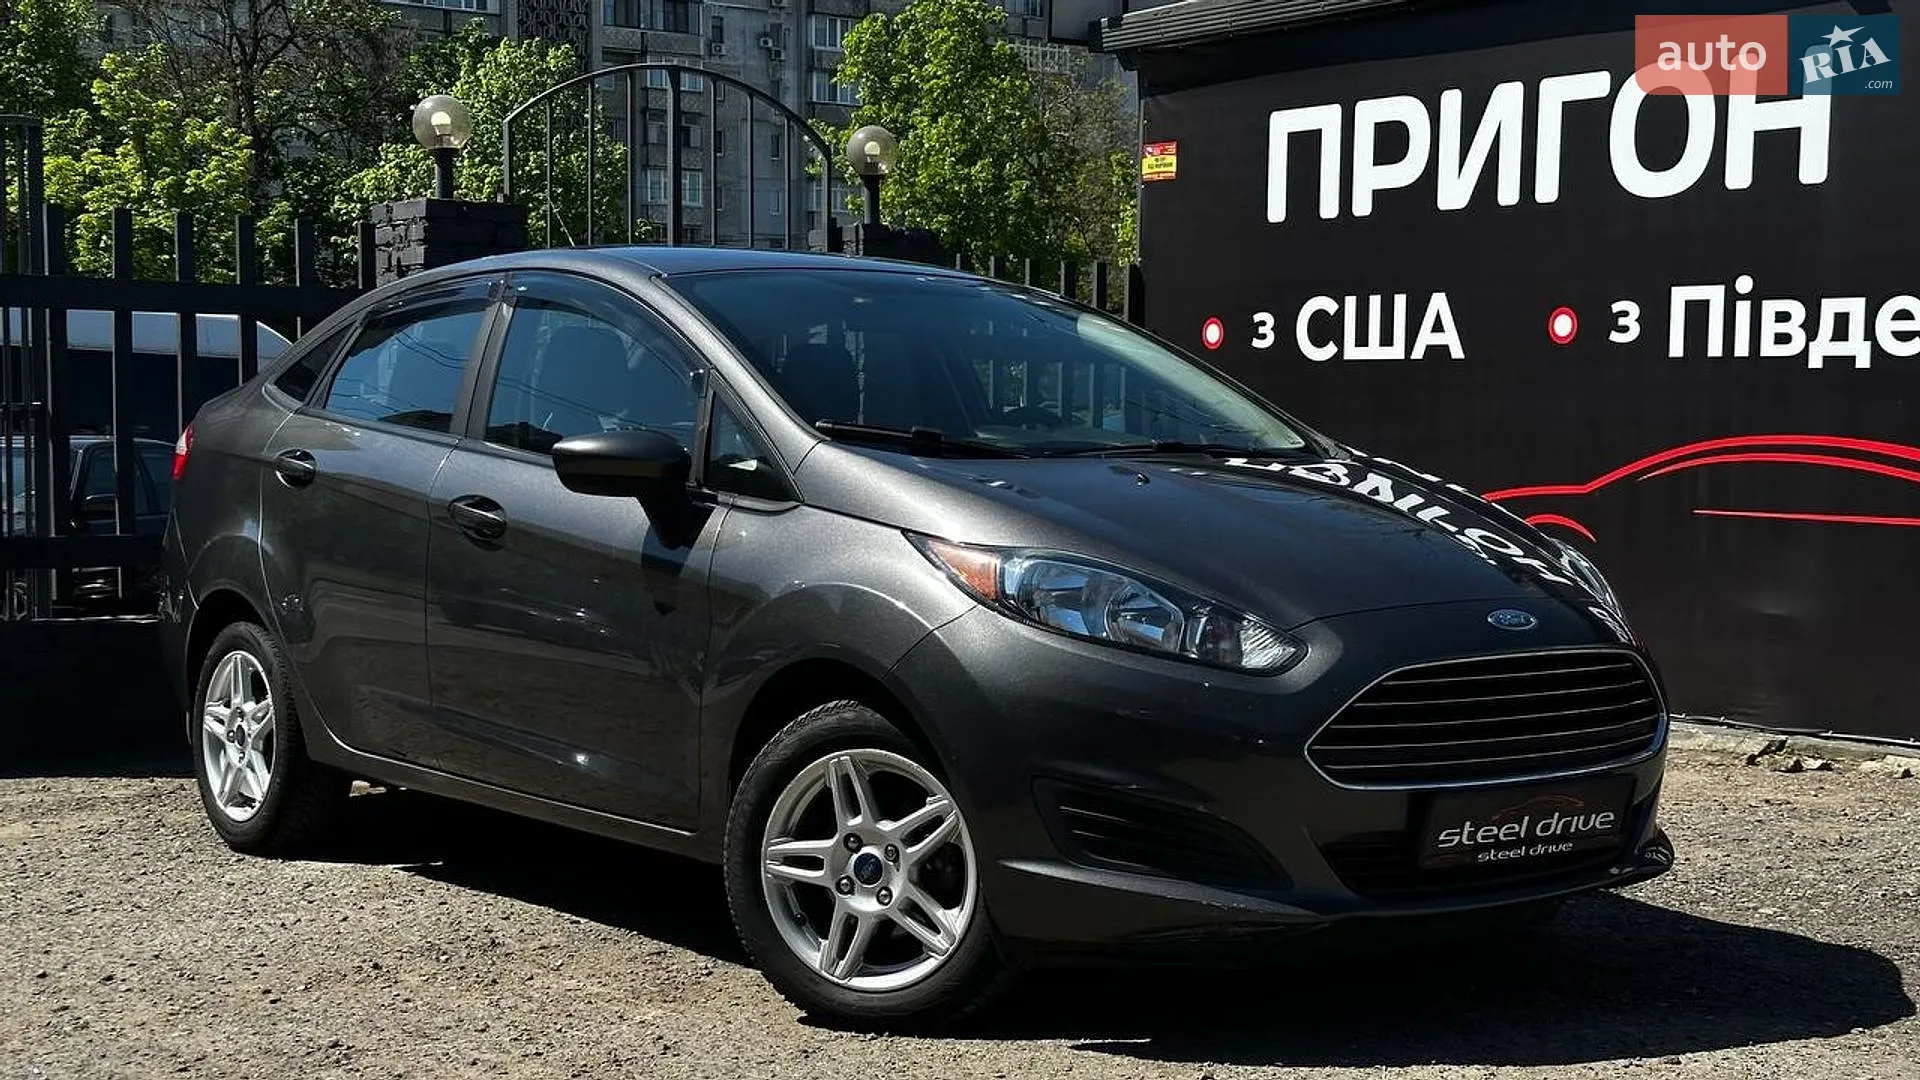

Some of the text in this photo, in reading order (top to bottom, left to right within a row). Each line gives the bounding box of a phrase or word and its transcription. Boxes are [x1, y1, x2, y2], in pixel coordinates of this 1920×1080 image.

[1267, 43, 1833, 223] ПРИГОН
[1295, 292, 1466, 362] США
[1668, 274, 1920, 369] Півде
[1437, 811, 1615, 848] steel drive
[1477, 842, 1574, 862] steel drive
